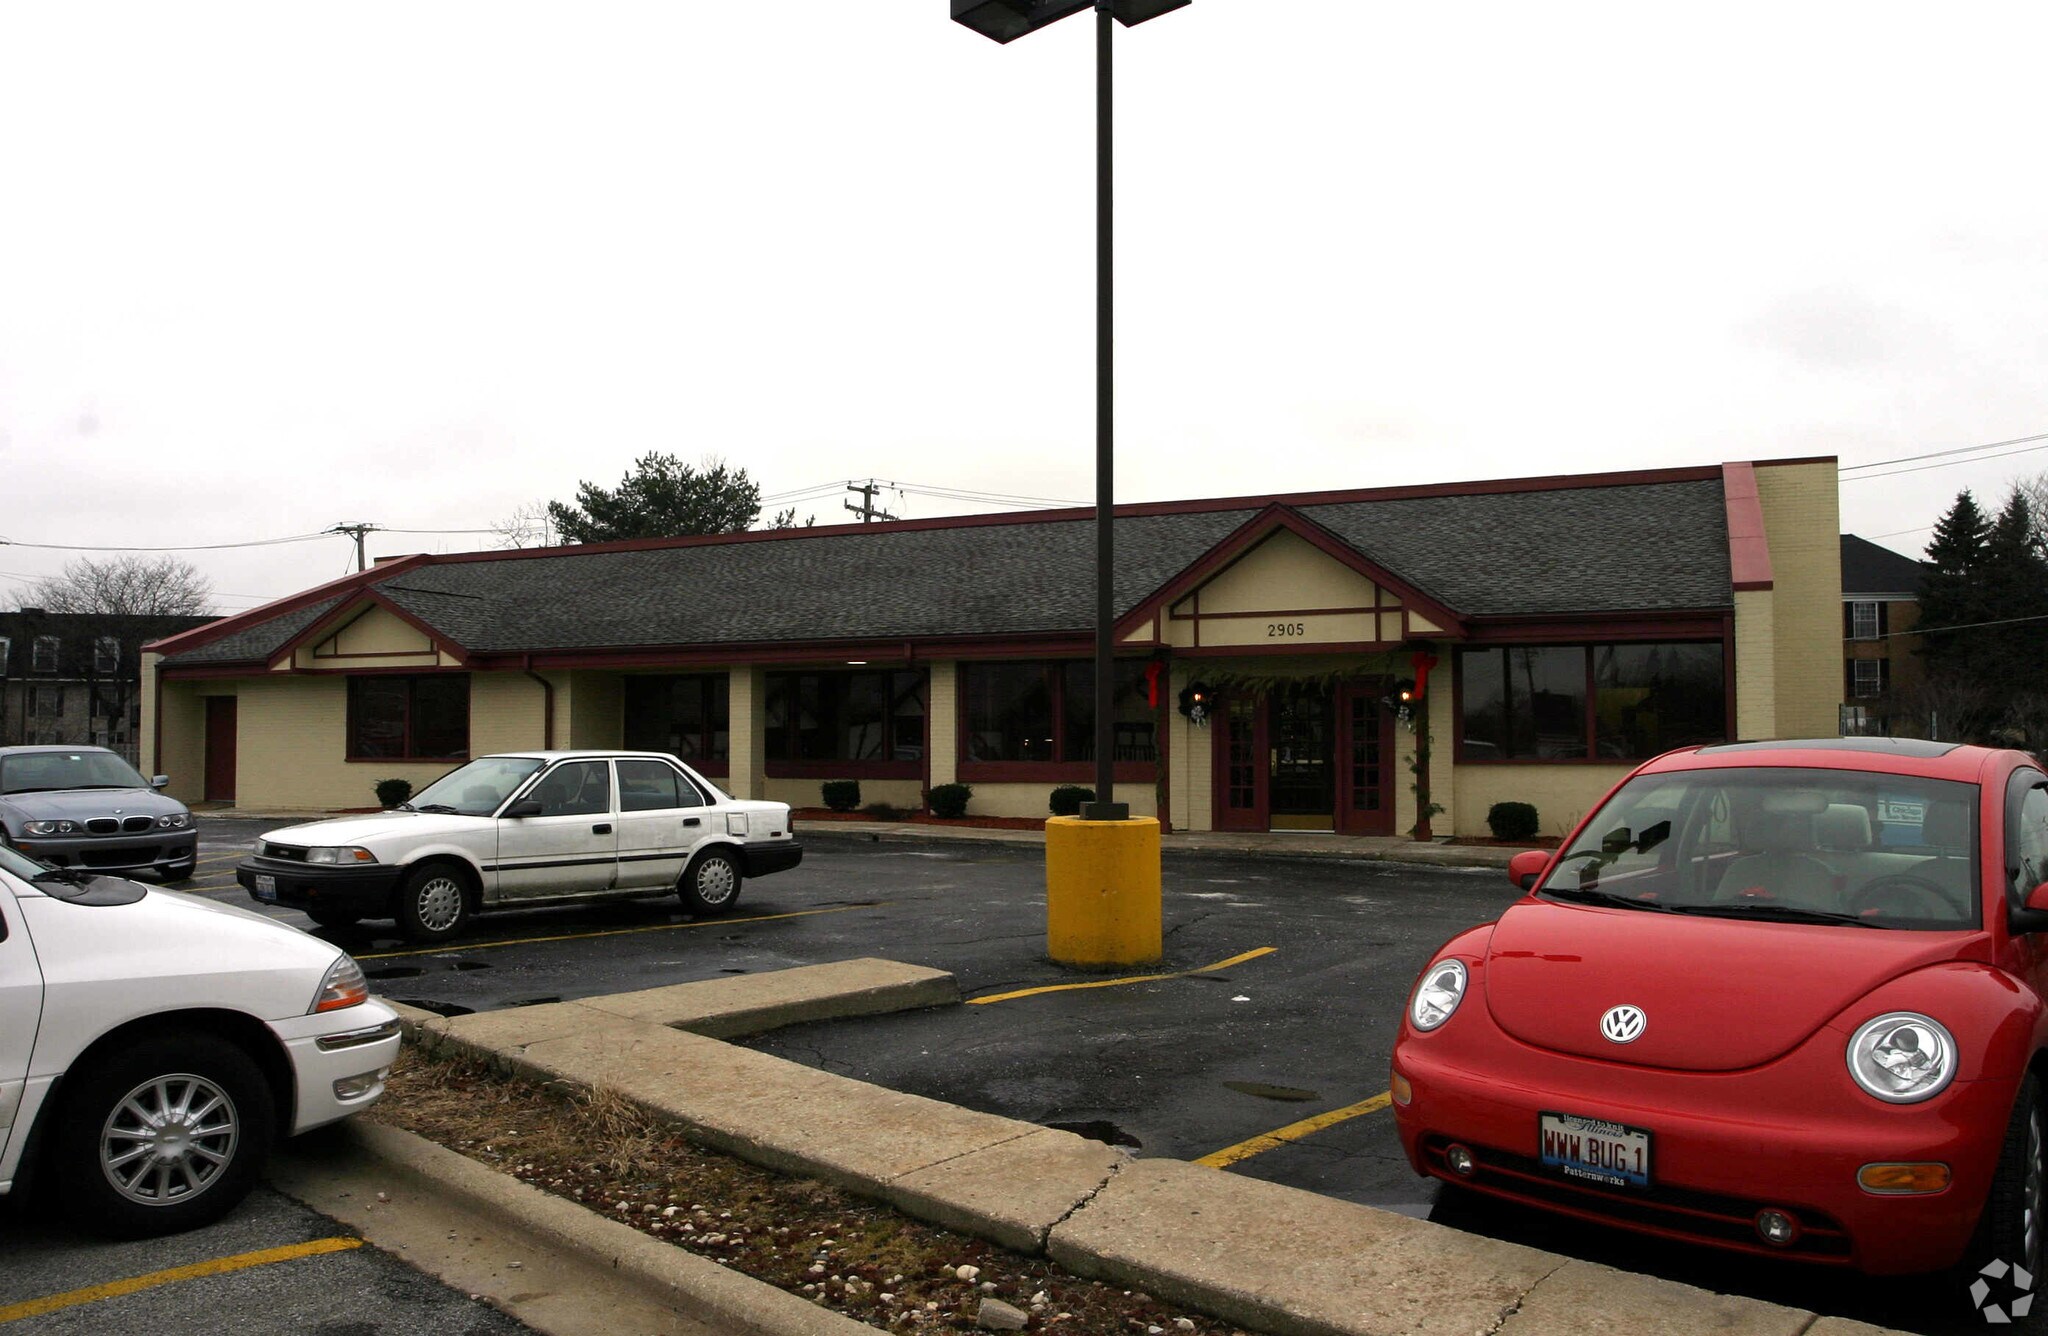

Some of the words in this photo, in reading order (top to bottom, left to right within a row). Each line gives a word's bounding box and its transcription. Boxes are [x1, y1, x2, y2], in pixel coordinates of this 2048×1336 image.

[1268, 623, 1304, 637] 2905
[1602, 1005, 1645, 1042] VW
[1543, 1129, 1581, 1162] WWW
[1633, 1147, 1645, 1176] 1
[1563, 1165, 1625, 1186] Patternworks
